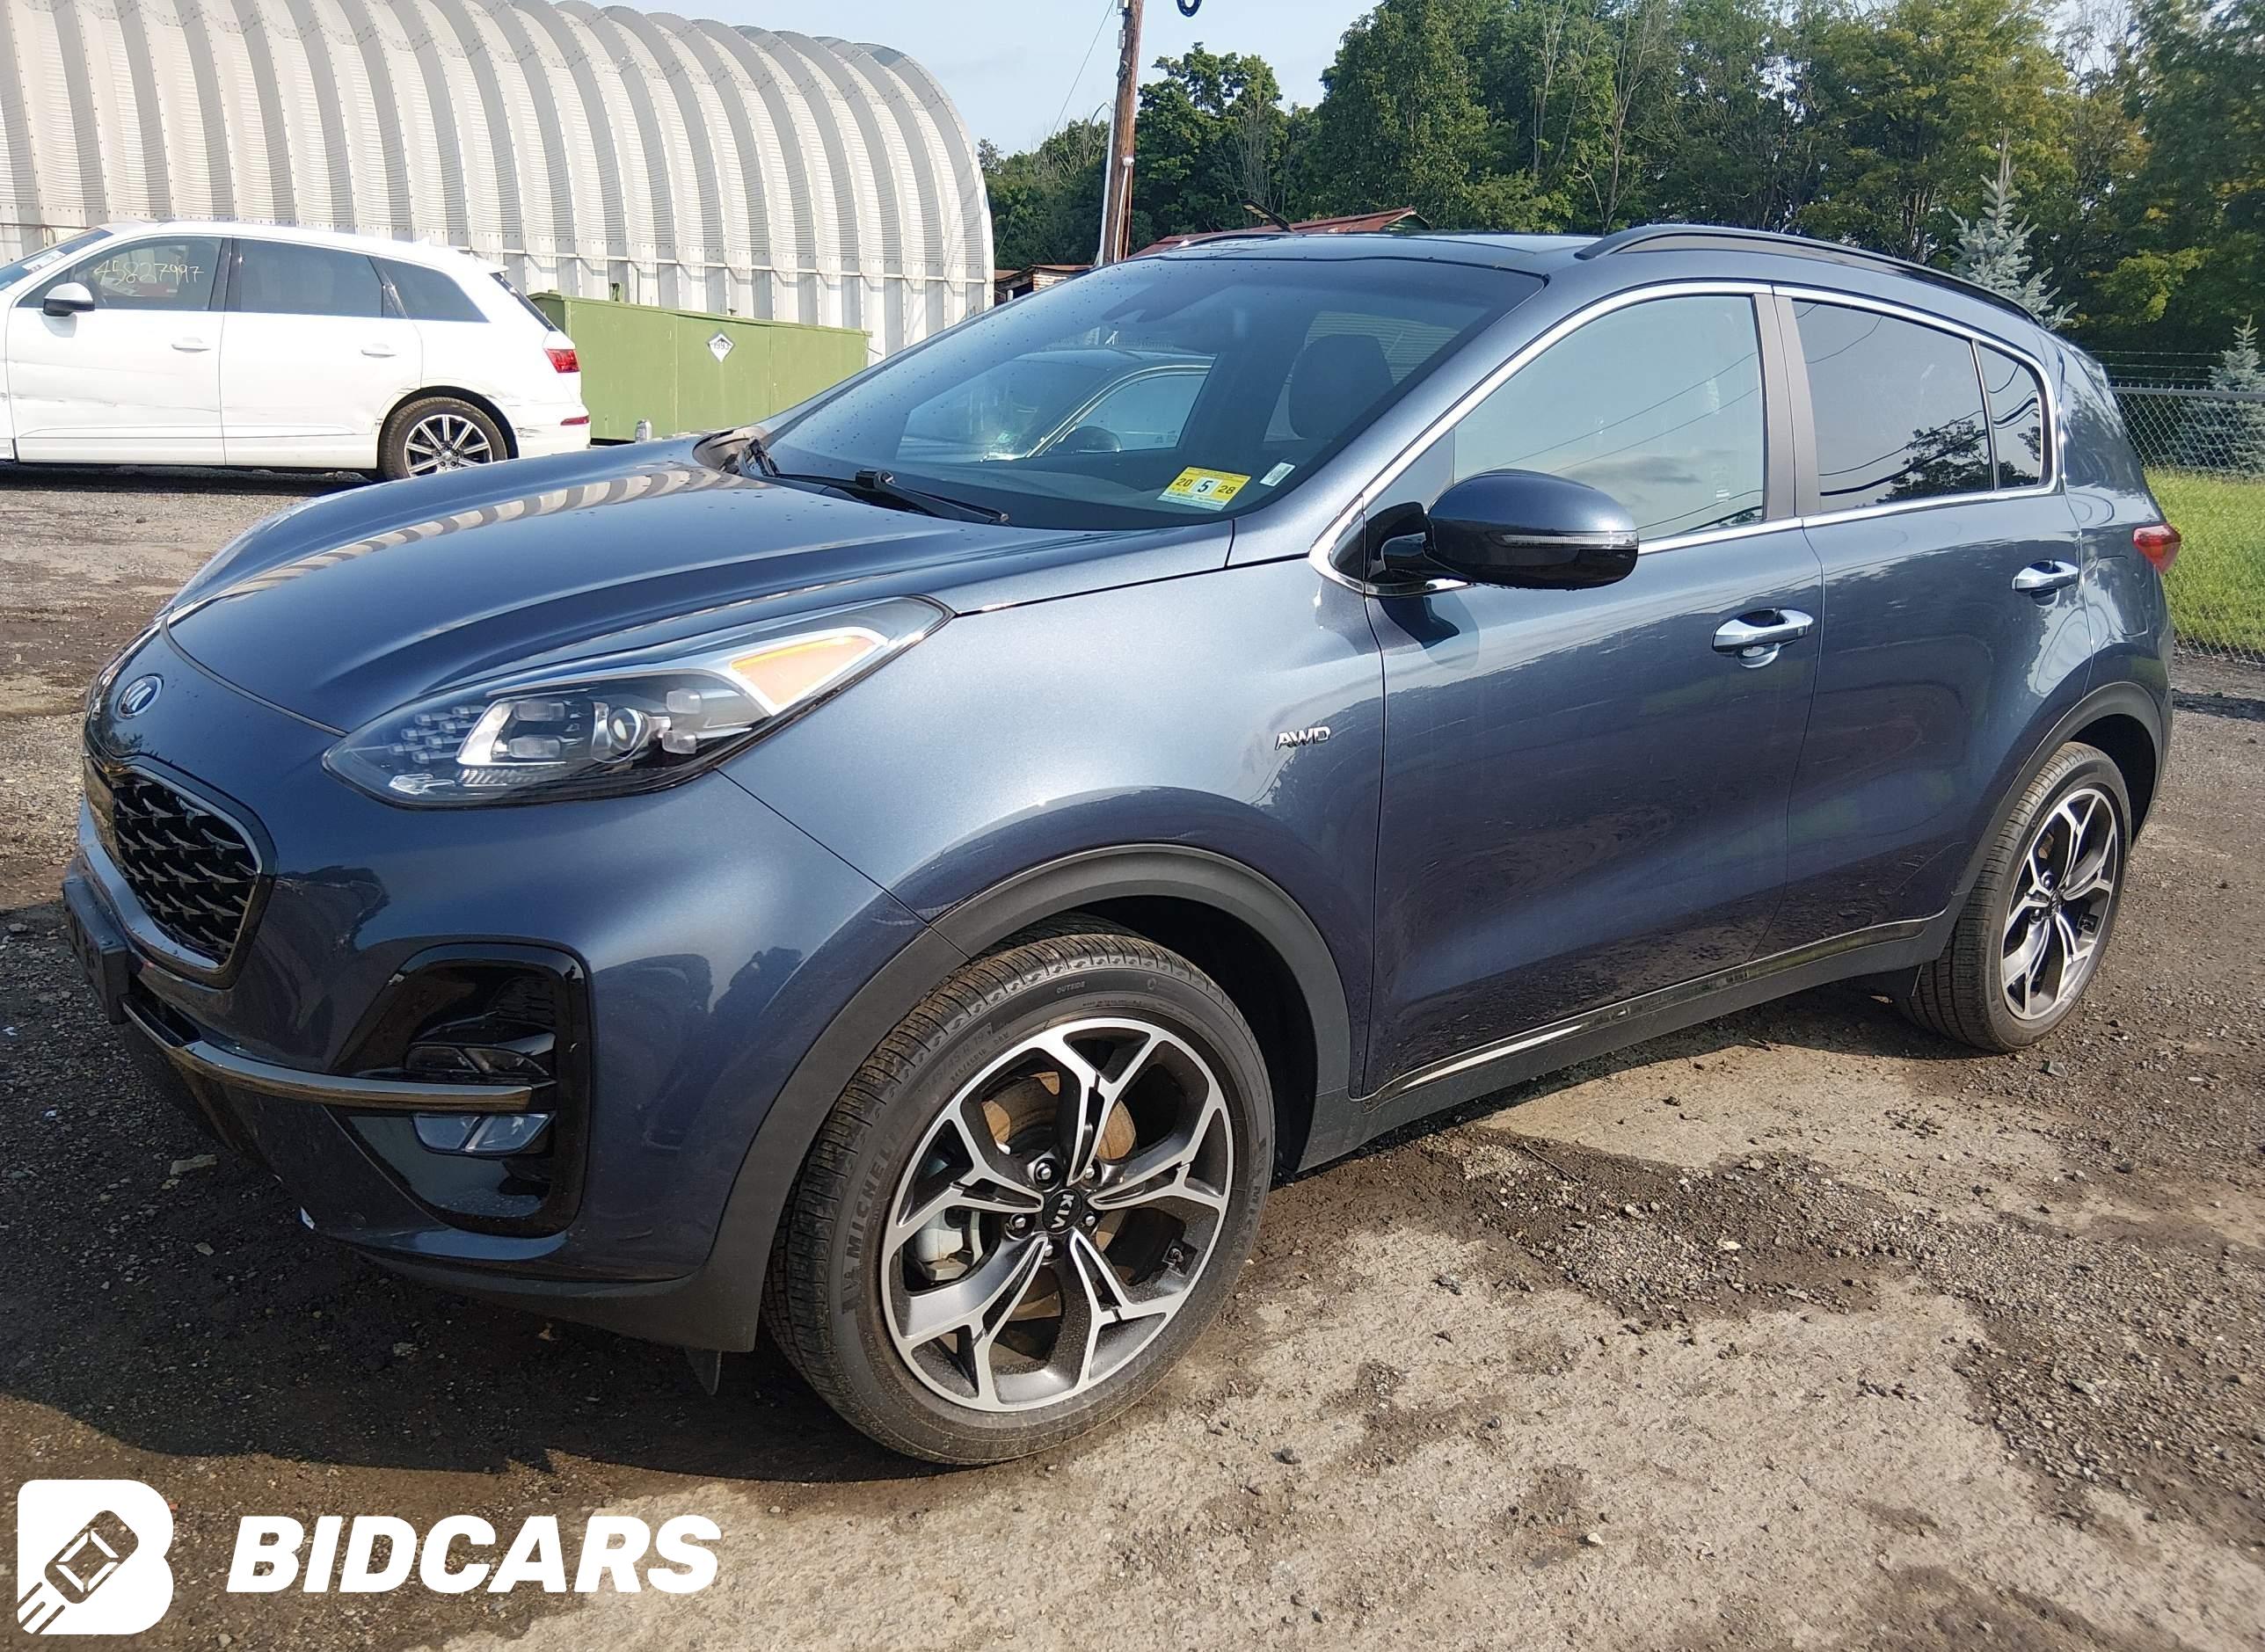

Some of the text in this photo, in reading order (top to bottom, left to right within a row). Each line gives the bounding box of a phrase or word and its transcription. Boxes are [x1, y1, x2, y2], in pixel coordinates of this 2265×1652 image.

[93, 260, 205, 286] 45827997
[1176, 477, 1193, 487] 20
[1198, 480, 1213, 492] 5
[1218, 484, 1236, 494] 28
[1274, 725, 1331, 751] AWD
[1056, 980, 1086, 993] OUTSIDE
[1051, 1194, 1074, 1229] KIA
